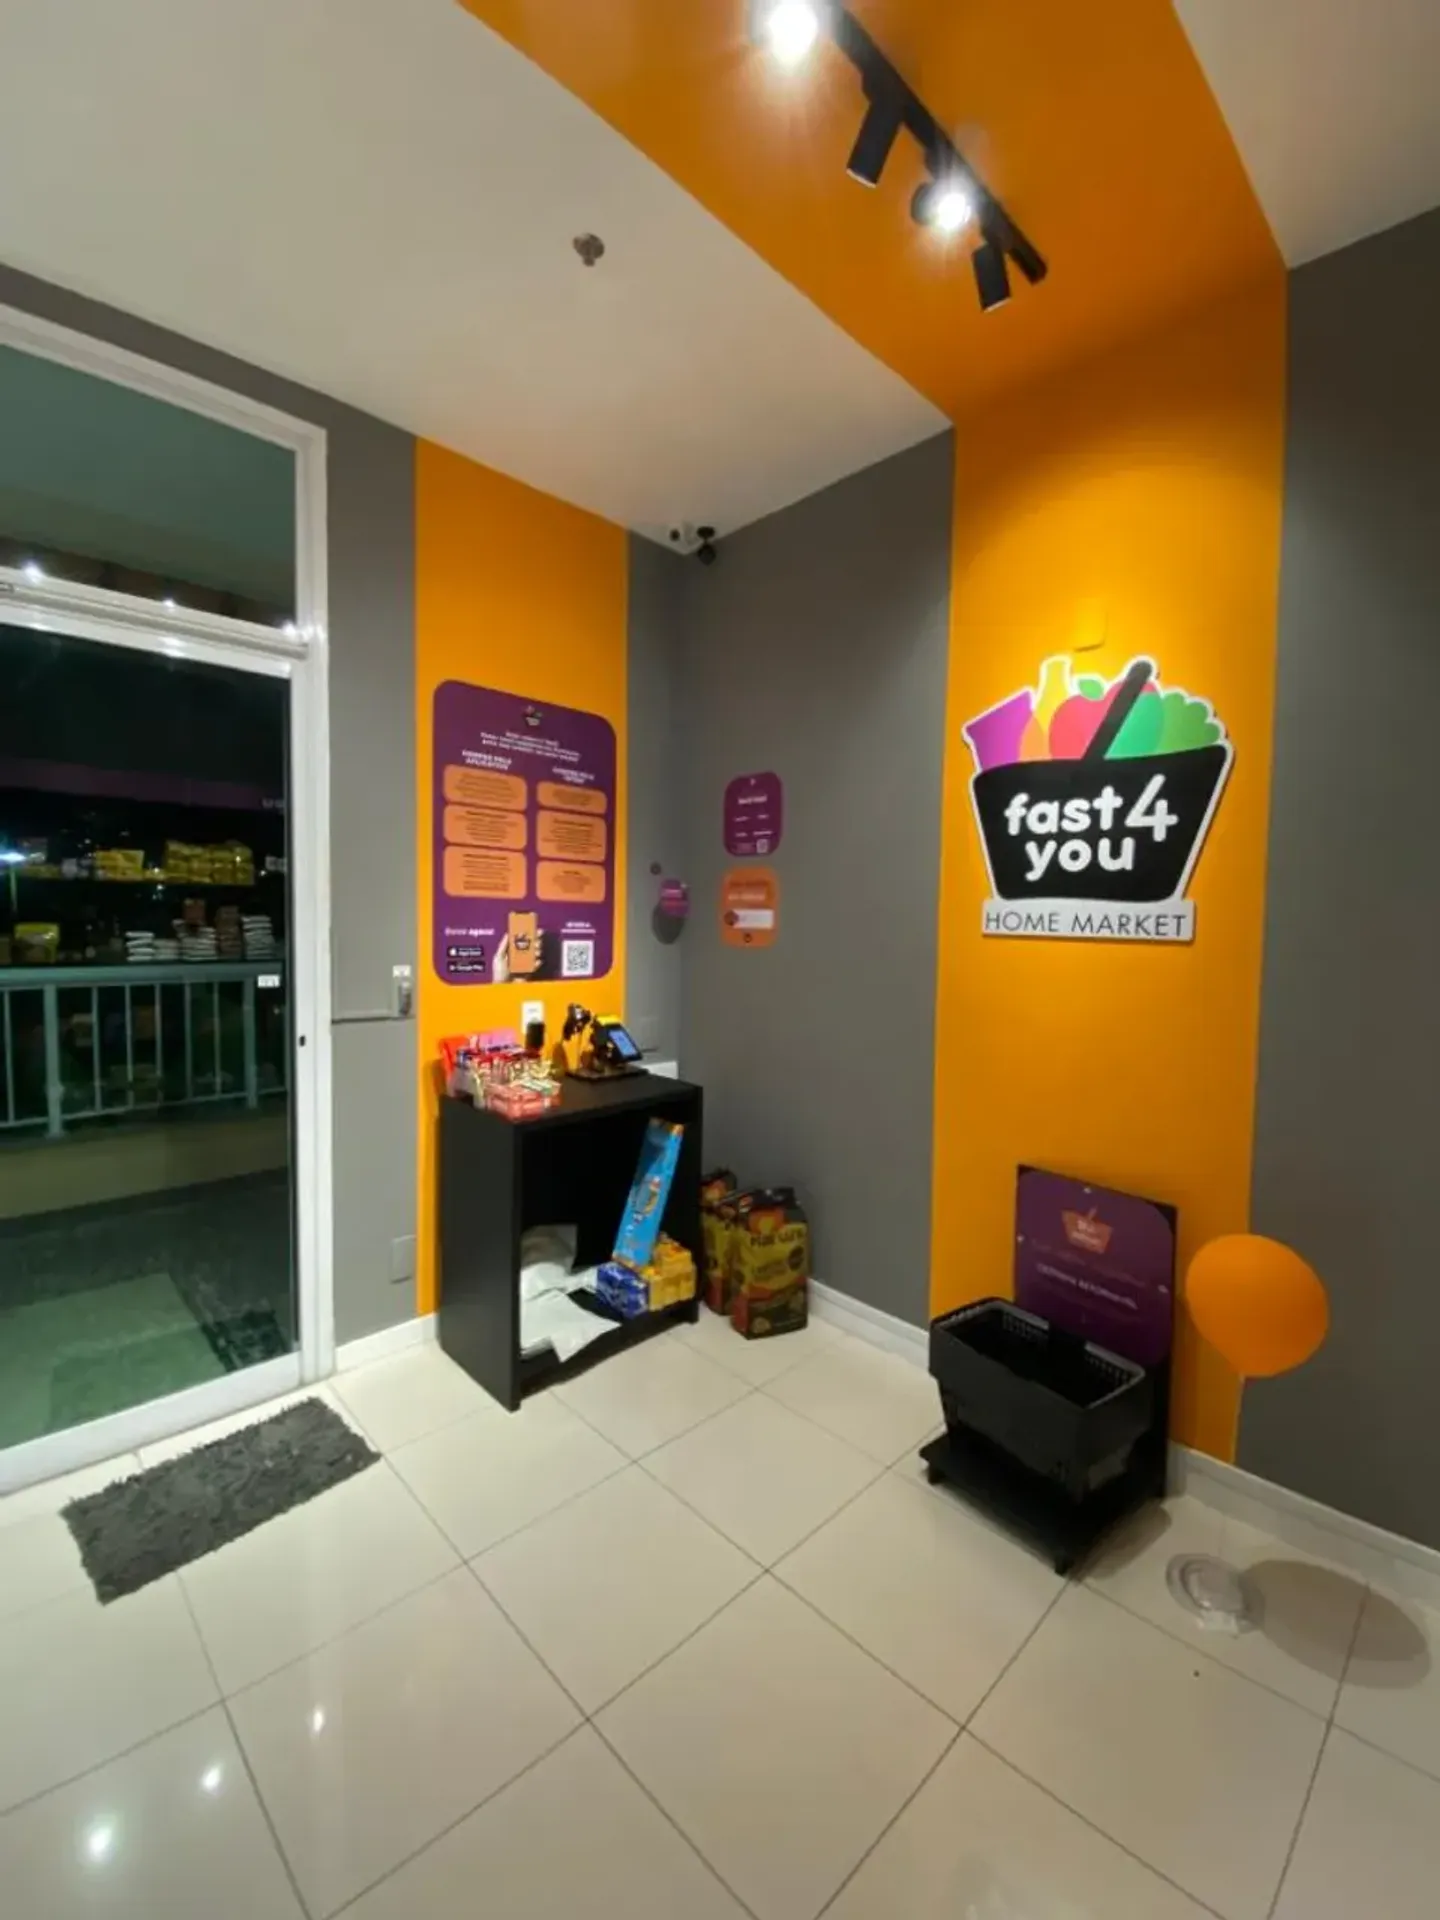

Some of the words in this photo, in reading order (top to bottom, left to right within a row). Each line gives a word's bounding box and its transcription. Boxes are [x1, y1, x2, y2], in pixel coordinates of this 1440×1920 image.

[1003, 786, 1123, 836] fast
[1124, 773, 1179, 842] 4
[1024, 835, 1136, 882] you
[985, 911, 1060, 933] HOME
[1071, 912, 1187, 938] MARKET
